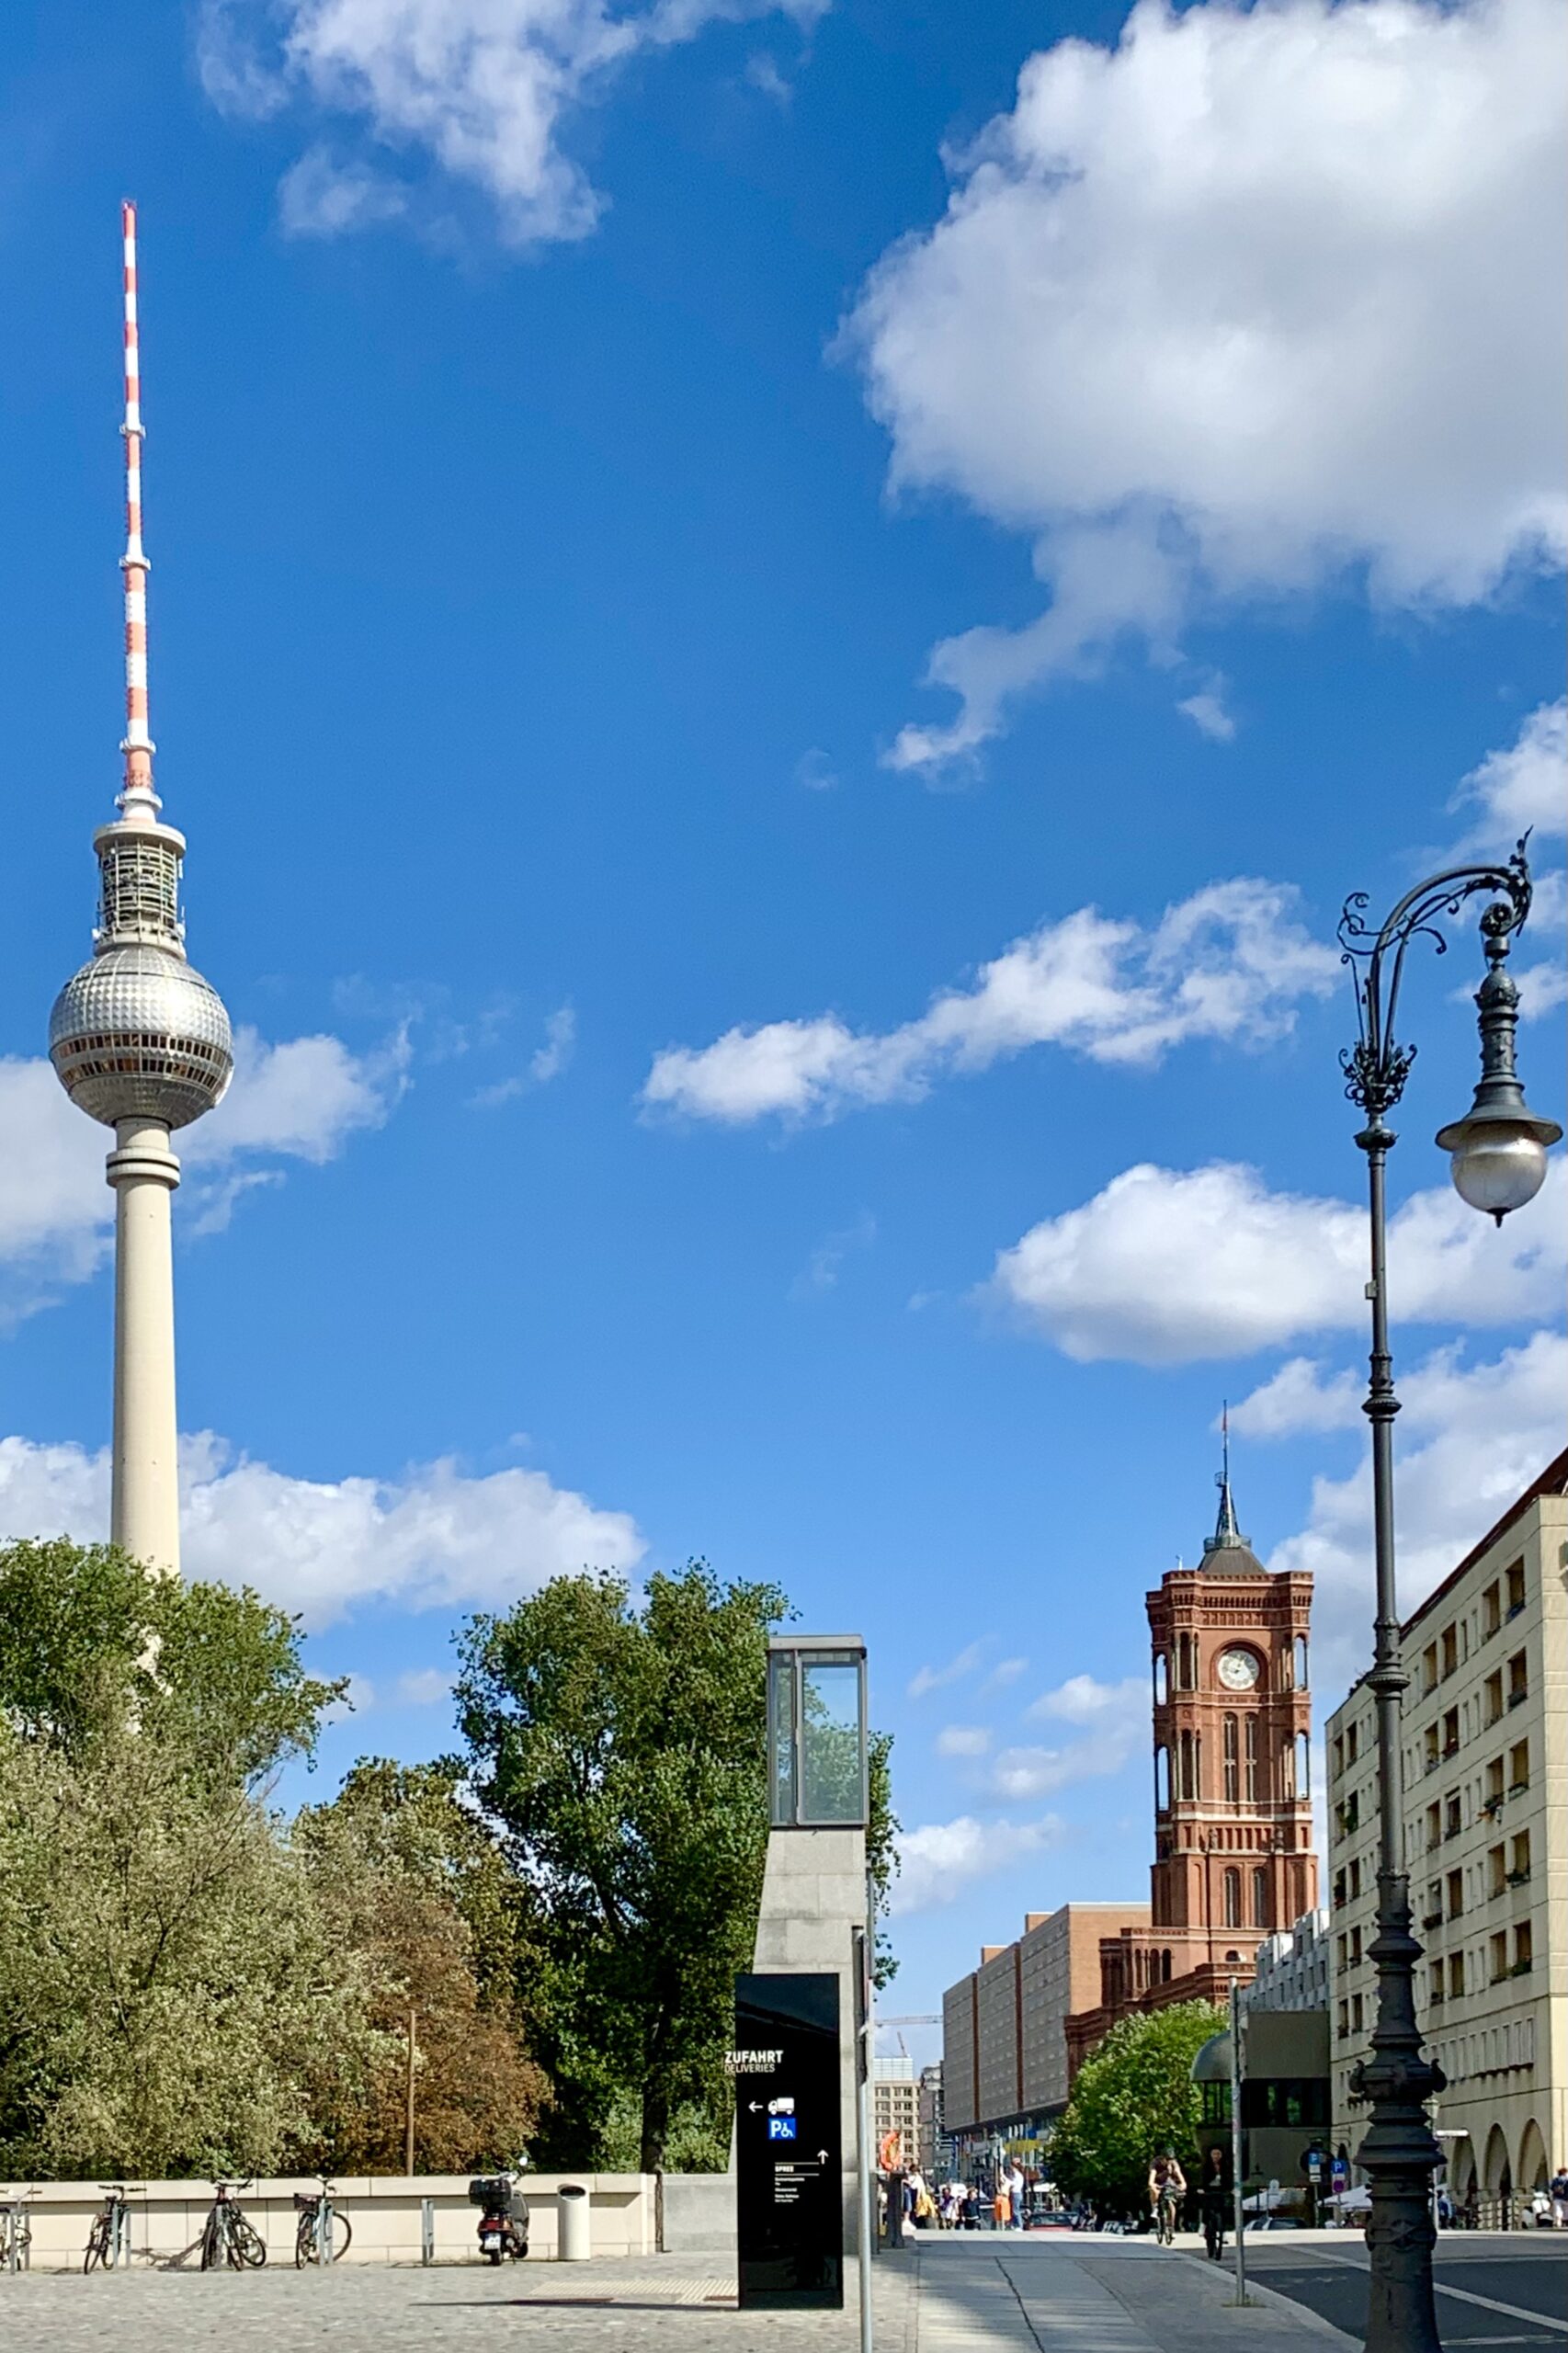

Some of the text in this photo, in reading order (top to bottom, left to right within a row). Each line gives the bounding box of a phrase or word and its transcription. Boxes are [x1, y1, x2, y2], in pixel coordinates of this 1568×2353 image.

[724, 2050, 784, 2063] ZUFAHRT
[724, 2063, 776, 2074] DELIVERIES
[770, 2120, 782, 2138] P
[1334, 2160, 1343, 2173] P
